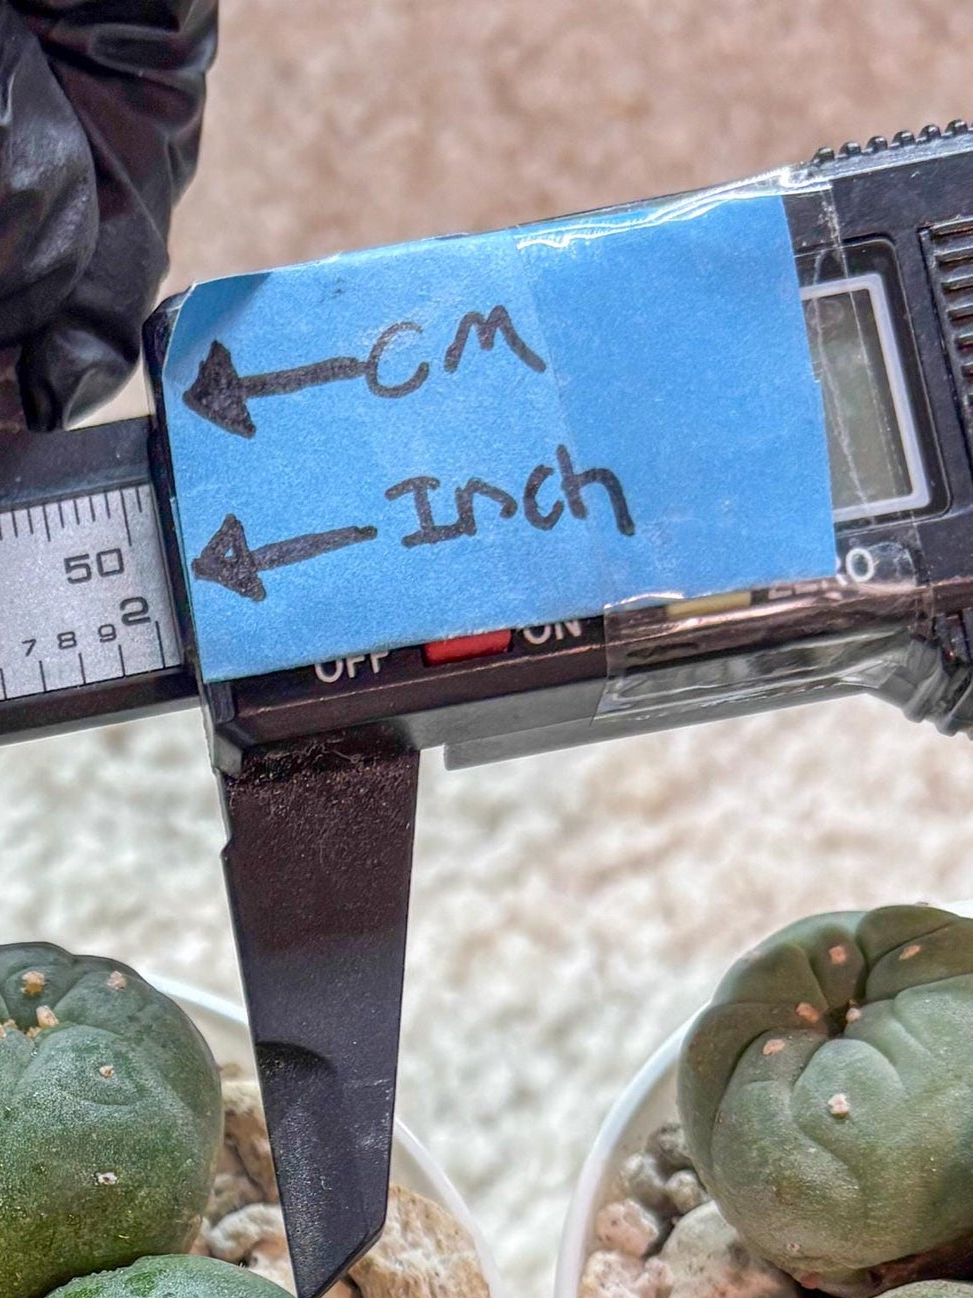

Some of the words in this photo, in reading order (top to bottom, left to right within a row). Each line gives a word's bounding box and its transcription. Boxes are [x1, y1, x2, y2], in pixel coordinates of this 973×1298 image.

[385, 444, 635, 549] Inch
[63, 547, 125, 585] 50
[21, 638, 37, 657] 7
[57, 631, 78, 650] 8
[97, 623, 118, 643] 9
[119, 596, 151, 626] 2
[313, 651, 390, 684] OFF
[522, 620, 584, 645] ON
